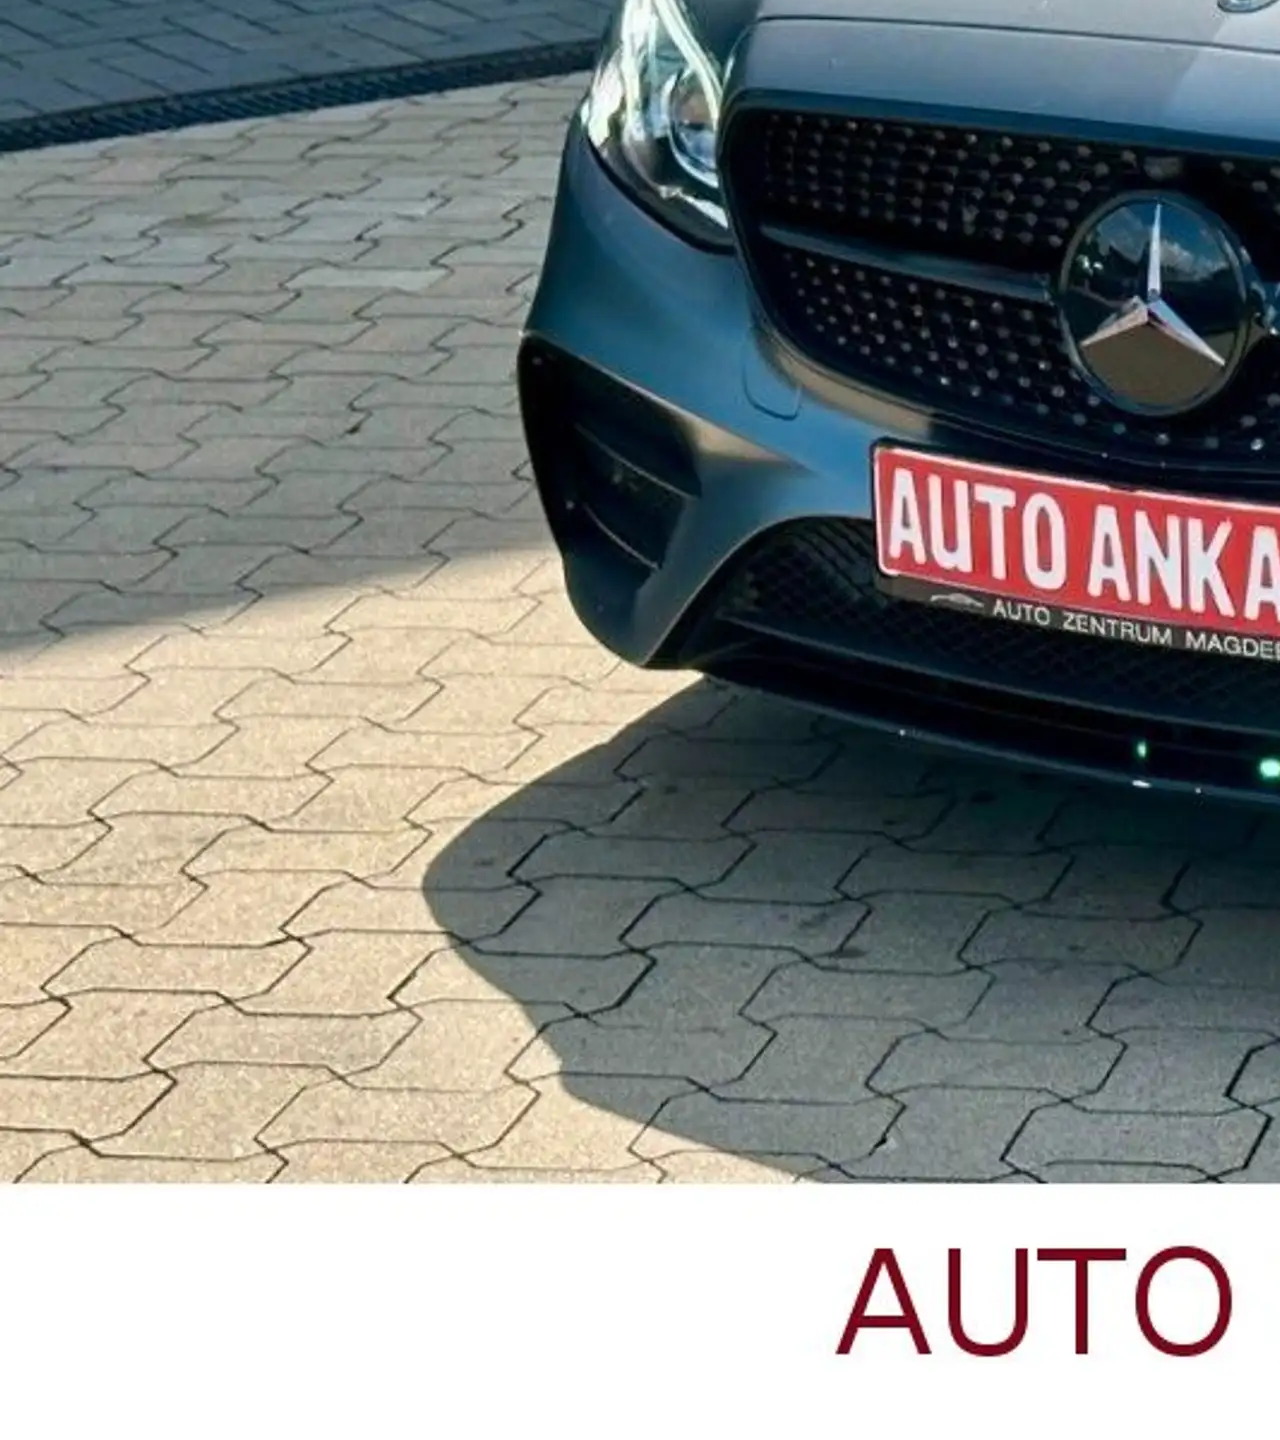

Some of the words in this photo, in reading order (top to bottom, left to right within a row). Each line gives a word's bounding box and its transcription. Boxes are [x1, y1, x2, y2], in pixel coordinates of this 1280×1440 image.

[888, 467, 1067, 591] AUTO
[992, 598, 1050, 626] AUTO
[1062, 612, 1173, 648] ZENTRUM
